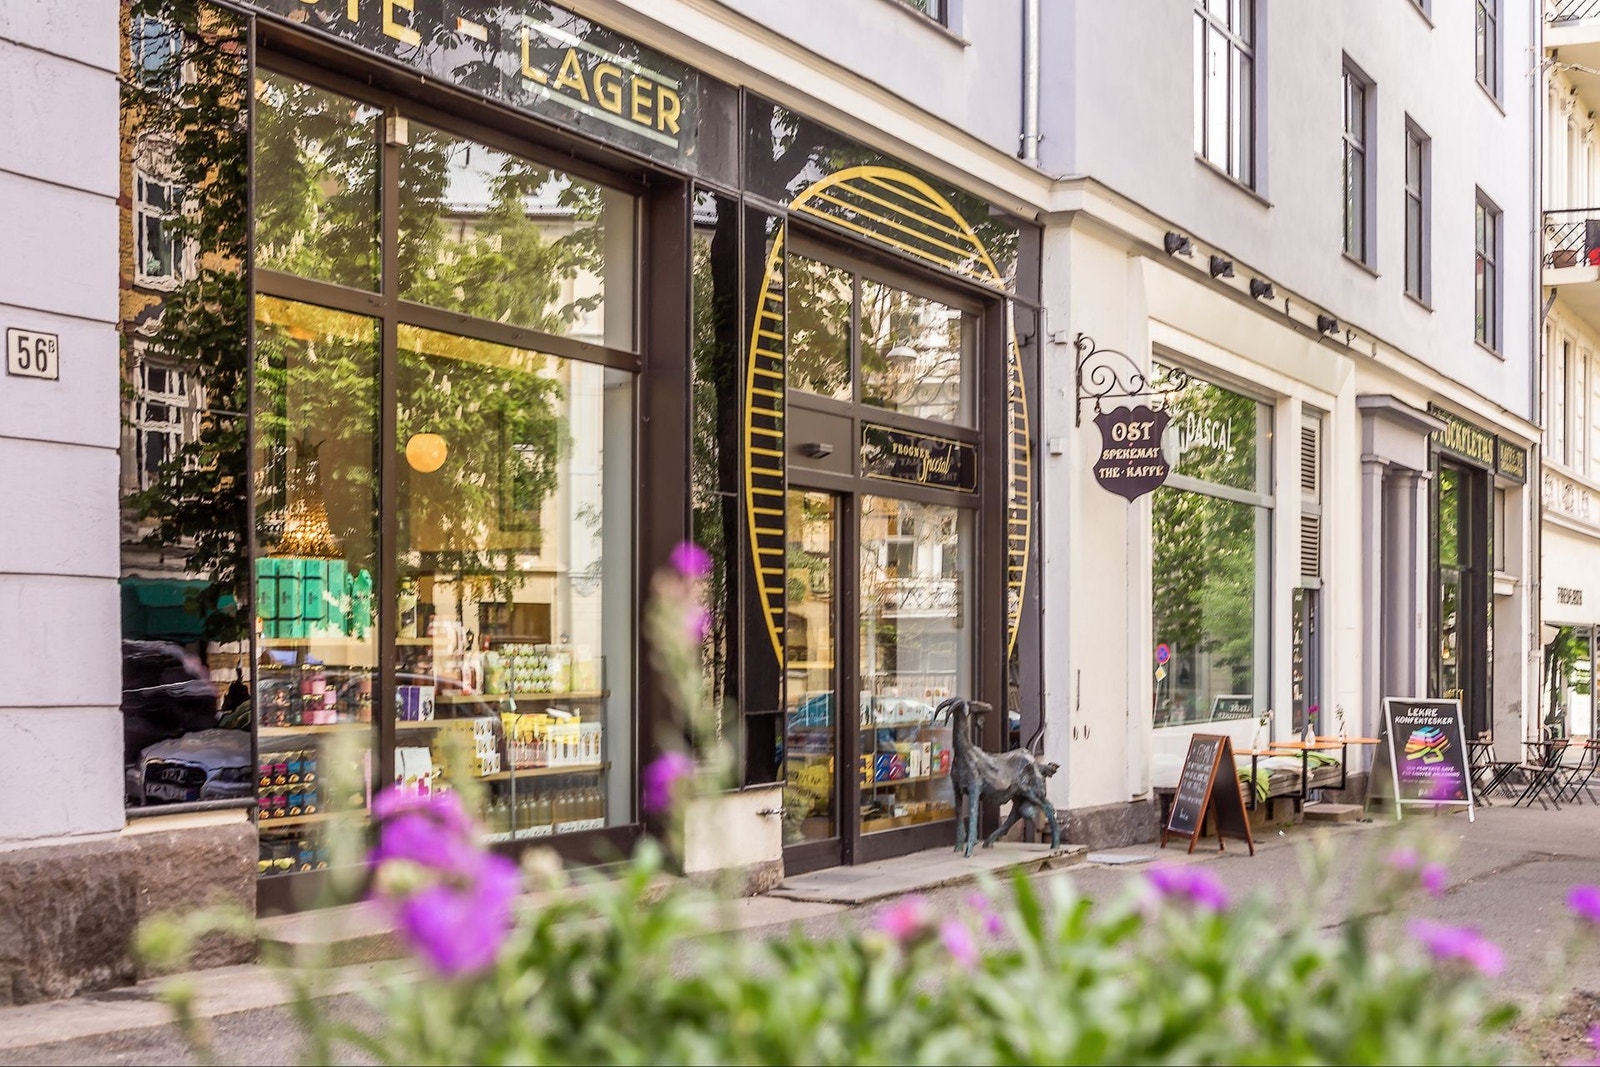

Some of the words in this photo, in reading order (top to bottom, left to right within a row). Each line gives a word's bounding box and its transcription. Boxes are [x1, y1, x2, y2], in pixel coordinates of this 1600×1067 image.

[521, 27, 681, 135] LAGER
[1111, 420, 1155, 442] OST
[1185, 411, 1237, 454] PASCAL
[1407, 707, 1439, 717] LEKRE
